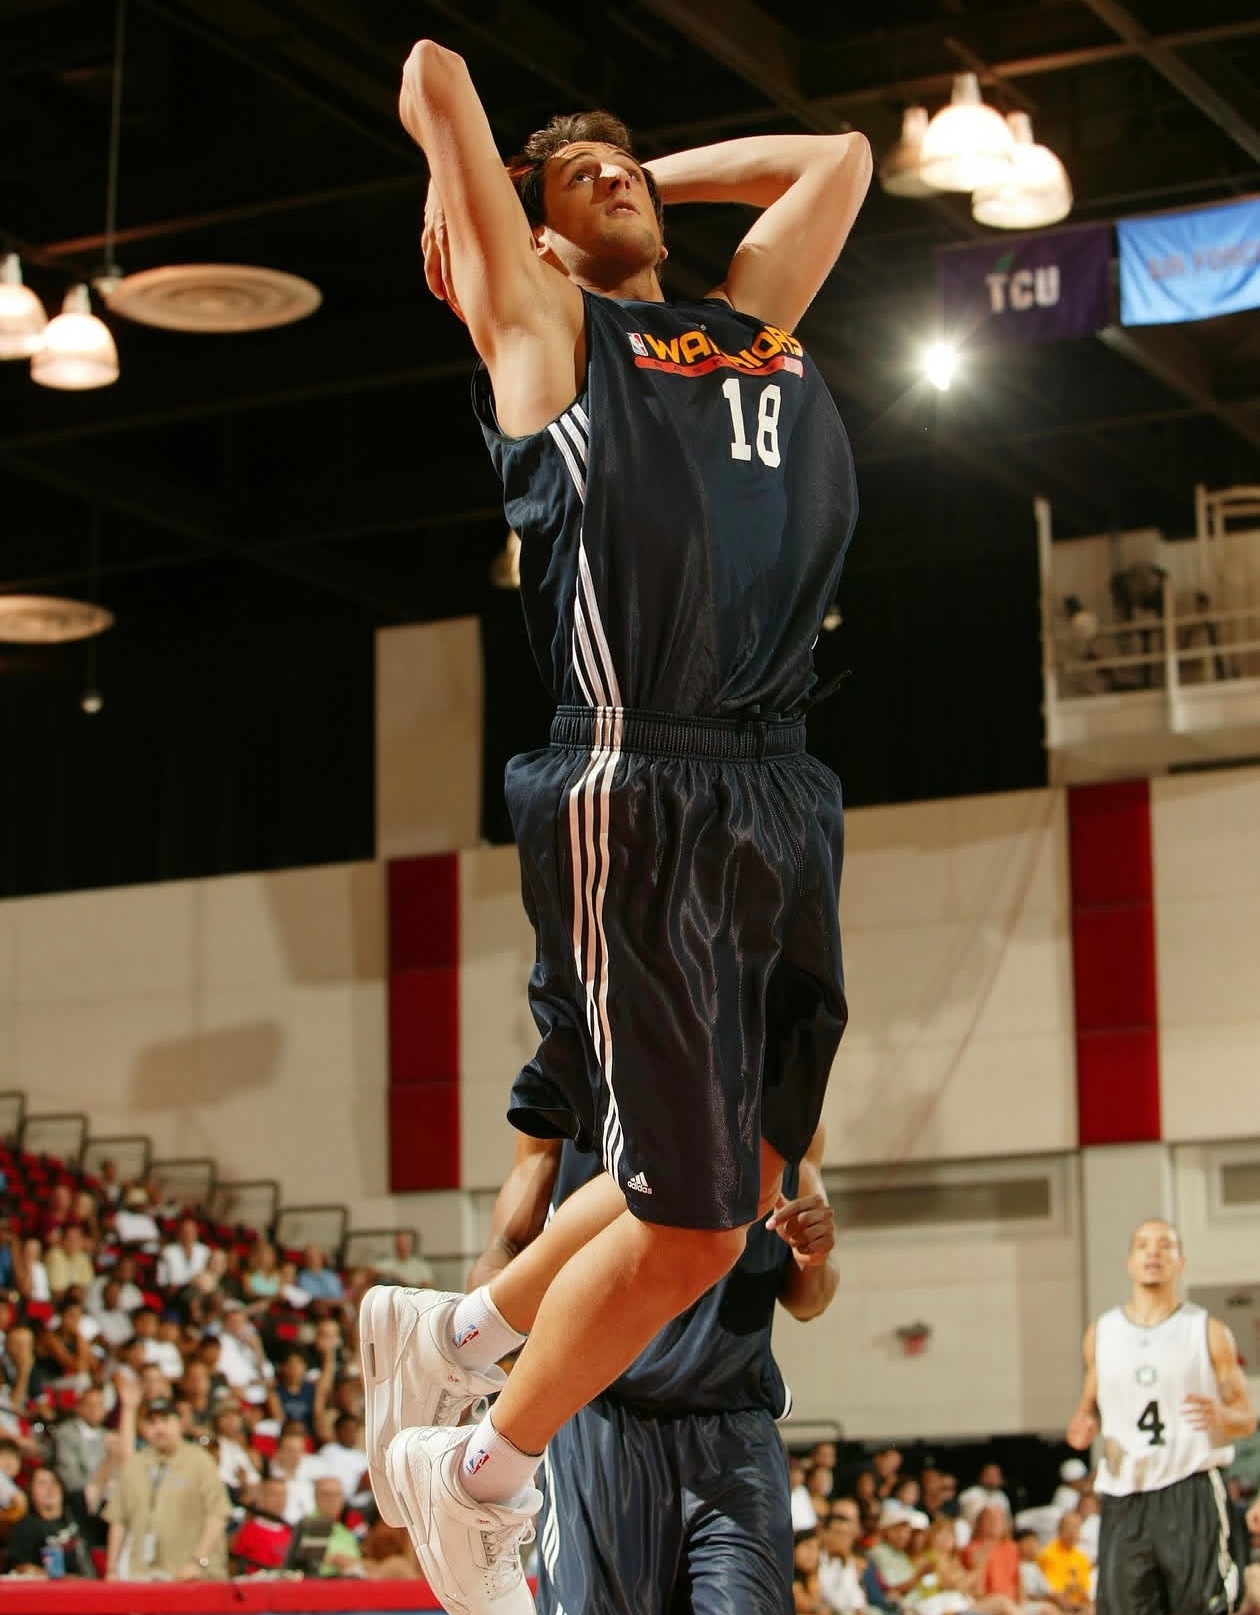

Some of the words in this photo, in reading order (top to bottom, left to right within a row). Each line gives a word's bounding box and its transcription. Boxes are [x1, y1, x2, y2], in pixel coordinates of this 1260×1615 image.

[984, 264, 1060, 313] TCU
[643, 325, 804, 369] WAIORS
[722, 377, 781, 468] 18
[627, 1180, 653, 1195] adidas
[1137, 1400, 1166, 1446] 4
